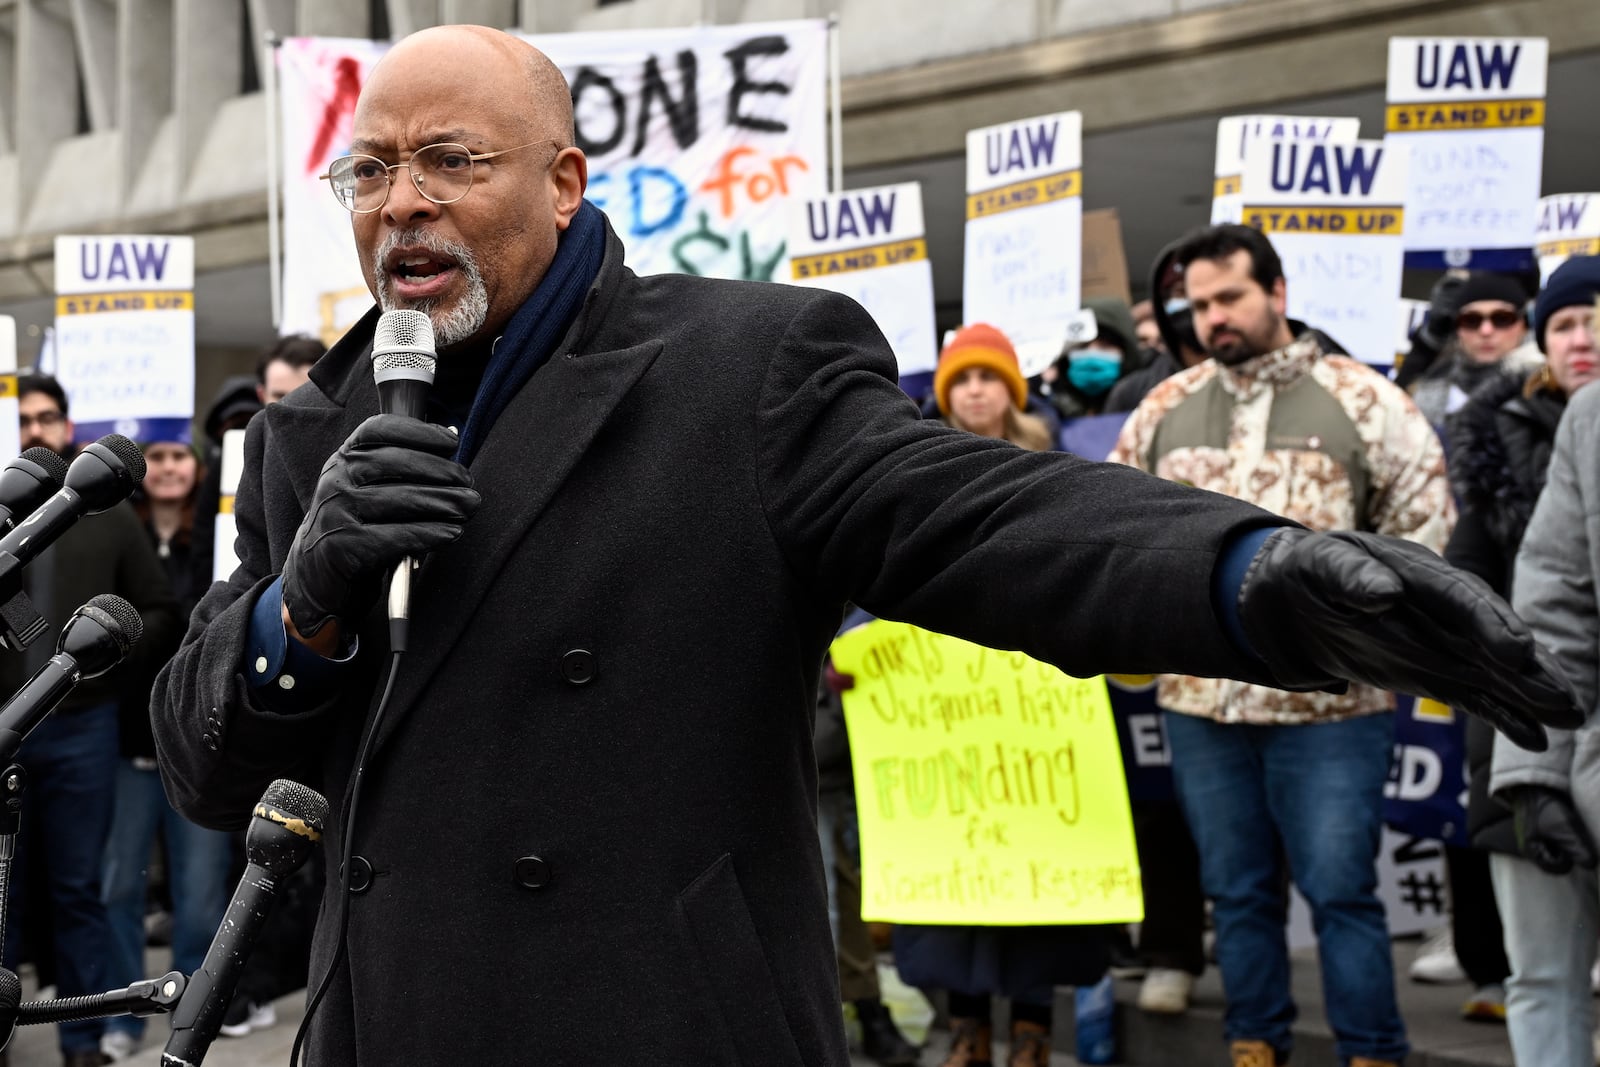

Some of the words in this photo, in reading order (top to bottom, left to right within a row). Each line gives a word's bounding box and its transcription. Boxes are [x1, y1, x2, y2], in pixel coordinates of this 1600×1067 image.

[1416, 44, 1520, 90] UAW
[1396, 108, 1488, 125] STAND
[1497, 106, 1535, 123] UP
[986, 121, 1059, 176] UAW
[702, 146, 809, 218] for
[1271, 142, 1384, 196] UAW
[974, 186, 1040, 214] STAND
[1046, 177, 1073, 197] UP
[807, 192, 896, 241] UAW
[1249, 214, 1346, 232] STAND
[1357, 214, 1396, 232] UP
[1536, 201, 1588, 232] AW
[81, 242, 170, 281] UAW
[799, 253, 878, 278] STAND
[886, 246, 917, 264] UP
[66, 300, 145, 314] STAND
[155, 297, 185, 310] UP
[899, 686, 1003, 732] wanna
[1016, 677, 1094, 728] have
